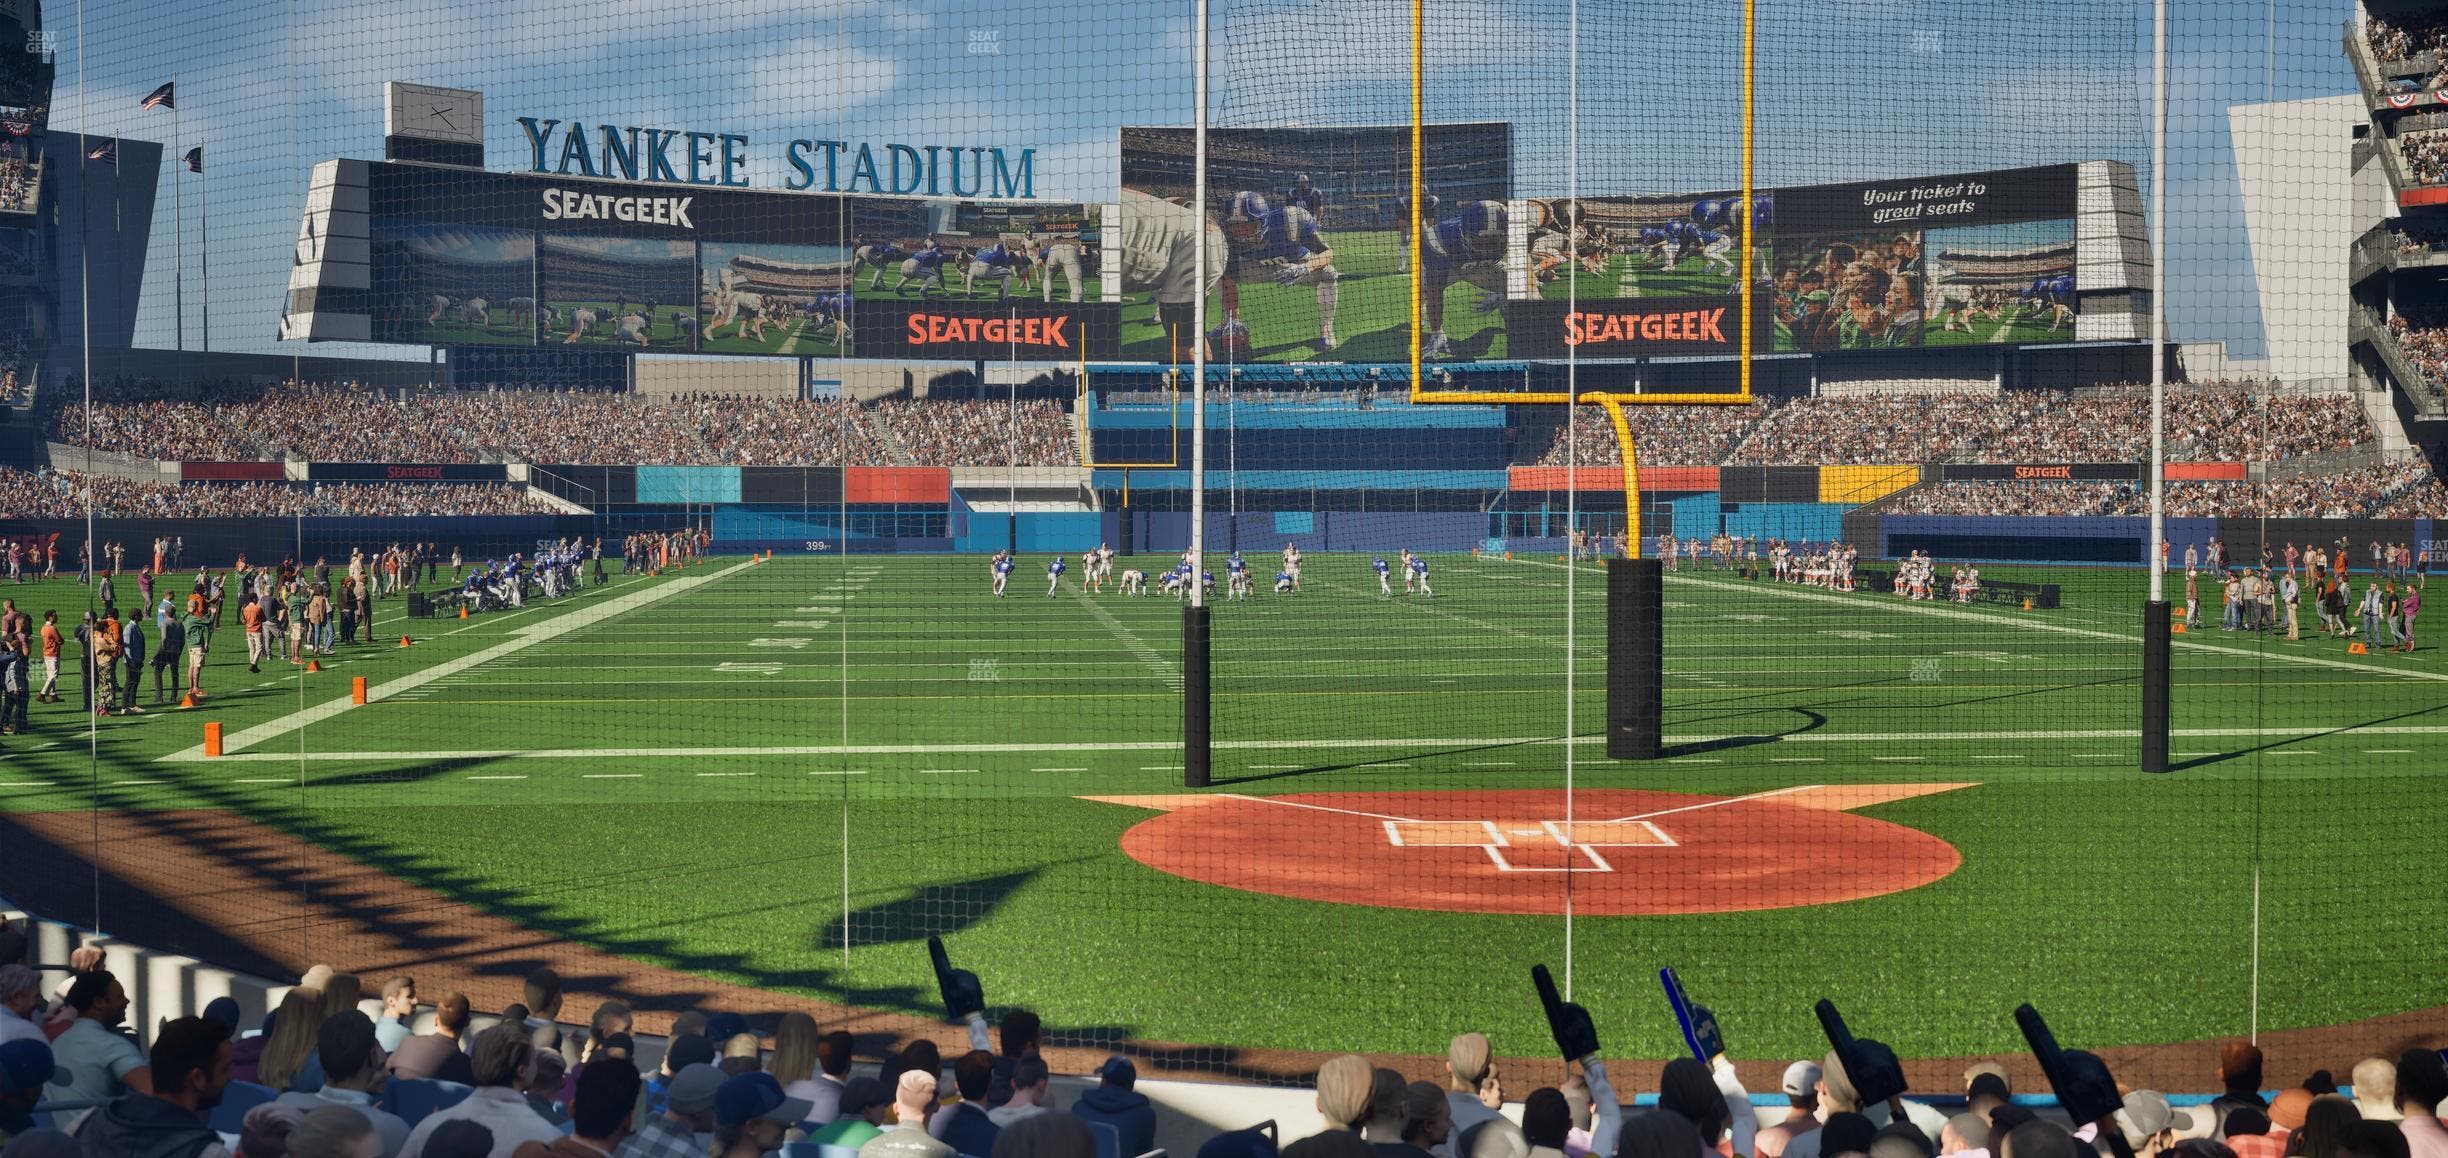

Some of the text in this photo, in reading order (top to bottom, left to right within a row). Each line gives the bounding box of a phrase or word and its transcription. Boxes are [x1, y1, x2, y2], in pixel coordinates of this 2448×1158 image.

[516, 117, 1037, 198] YANKEE STADIUM
[543, 188, 694, 229] SEATGEEK
[1864, 182, 1986, 206] Your ticket to
[1873, 199, 1975, 223] great seats
[908, 313, 1069, 348] SEATGEEK
[1564, 307, 1727, 346] SEATGEEK
[387, 465, 443, 479] SEATGEEK
[2015, 465, 2071, 479] SEATGEEK
